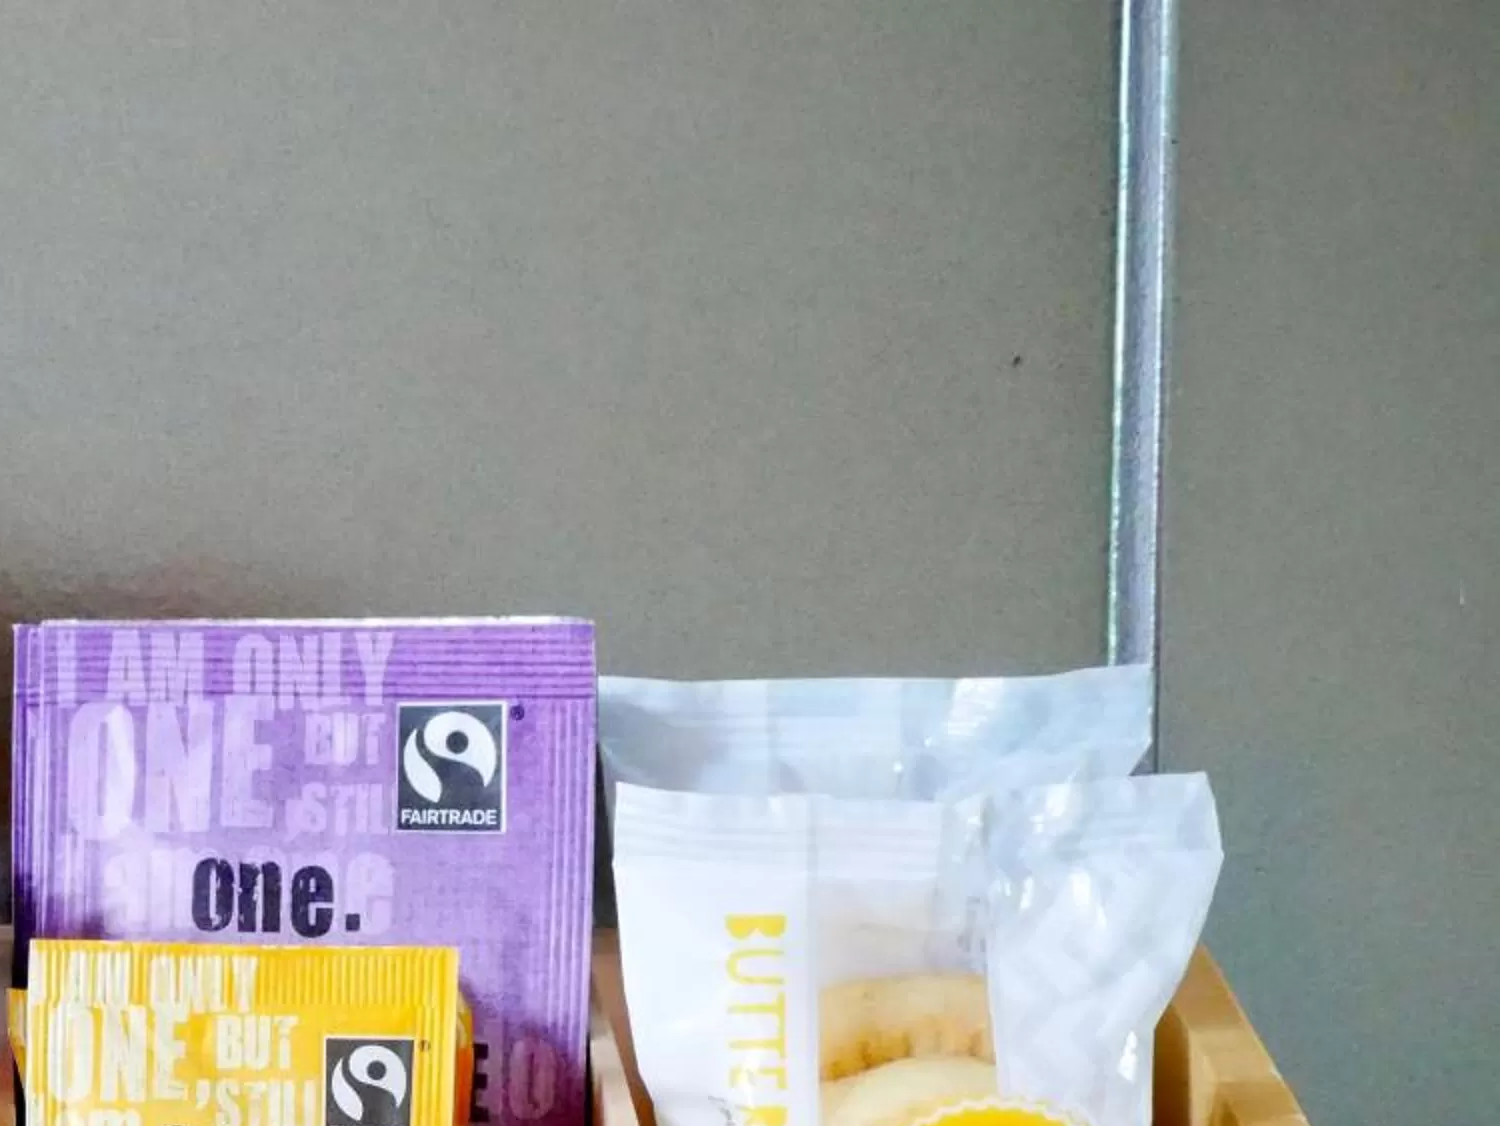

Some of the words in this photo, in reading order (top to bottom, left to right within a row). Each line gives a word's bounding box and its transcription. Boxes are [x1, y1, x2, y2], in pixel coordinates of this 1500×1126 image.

[106, 629, 204, 708] AM
[231, 630, 395, 711] ONLY
[303, 711, 386, 766] BUT
[400, 808, 498, 826] FAIRTRADE
[192, 857, 361, 938] one.
[215, 1014, 299, 1071] BUT
